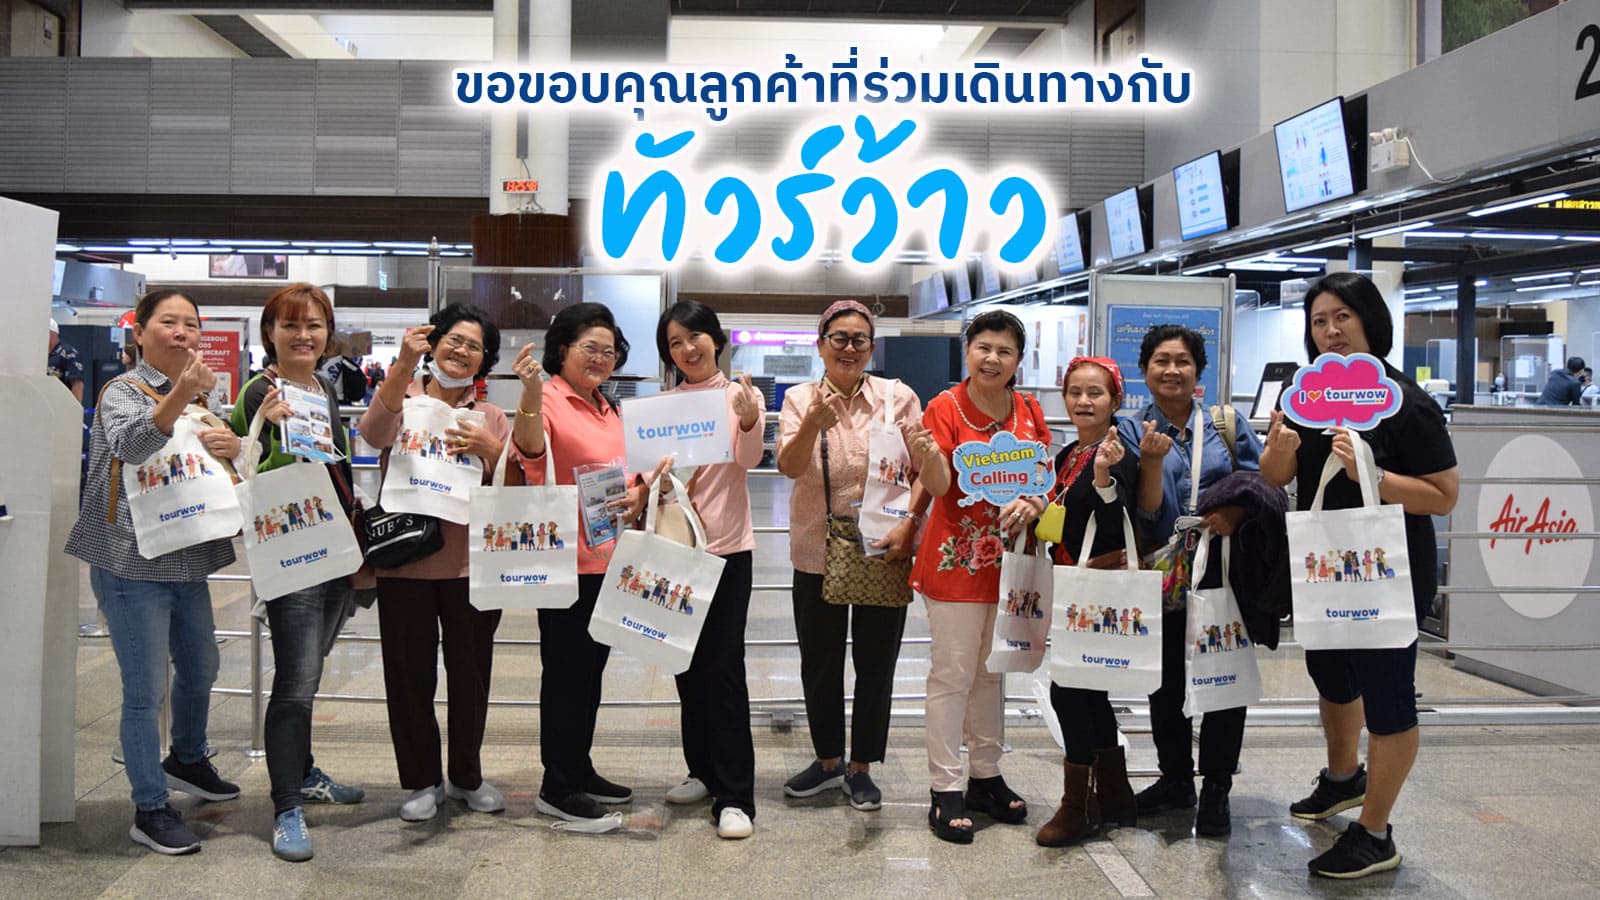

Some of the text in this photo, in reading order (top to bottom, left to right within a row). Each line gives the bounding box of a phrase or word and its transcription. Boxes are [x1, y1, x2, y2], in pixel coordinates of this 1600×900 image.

[1301, 389, 1386, 402] I tourwow
[636, 420, 716, 439] tourwow
[962, 447, 1035, 468] Vietnam
[410, 477, 452, 491] tourwow
[970, 471, 1028, 486] Calling
[160, 502, 206, 521] tourwow
[280, 548, 328, 567] tourwow
[500, 573, 548, 584] tourwow
[1326, 608, 1380, 618] tourwow
[622, 616, 667, 640] tourwow
[1082, 654, 1130, 667] tourwow
[1192, 674, 1237, 686] tourwow
